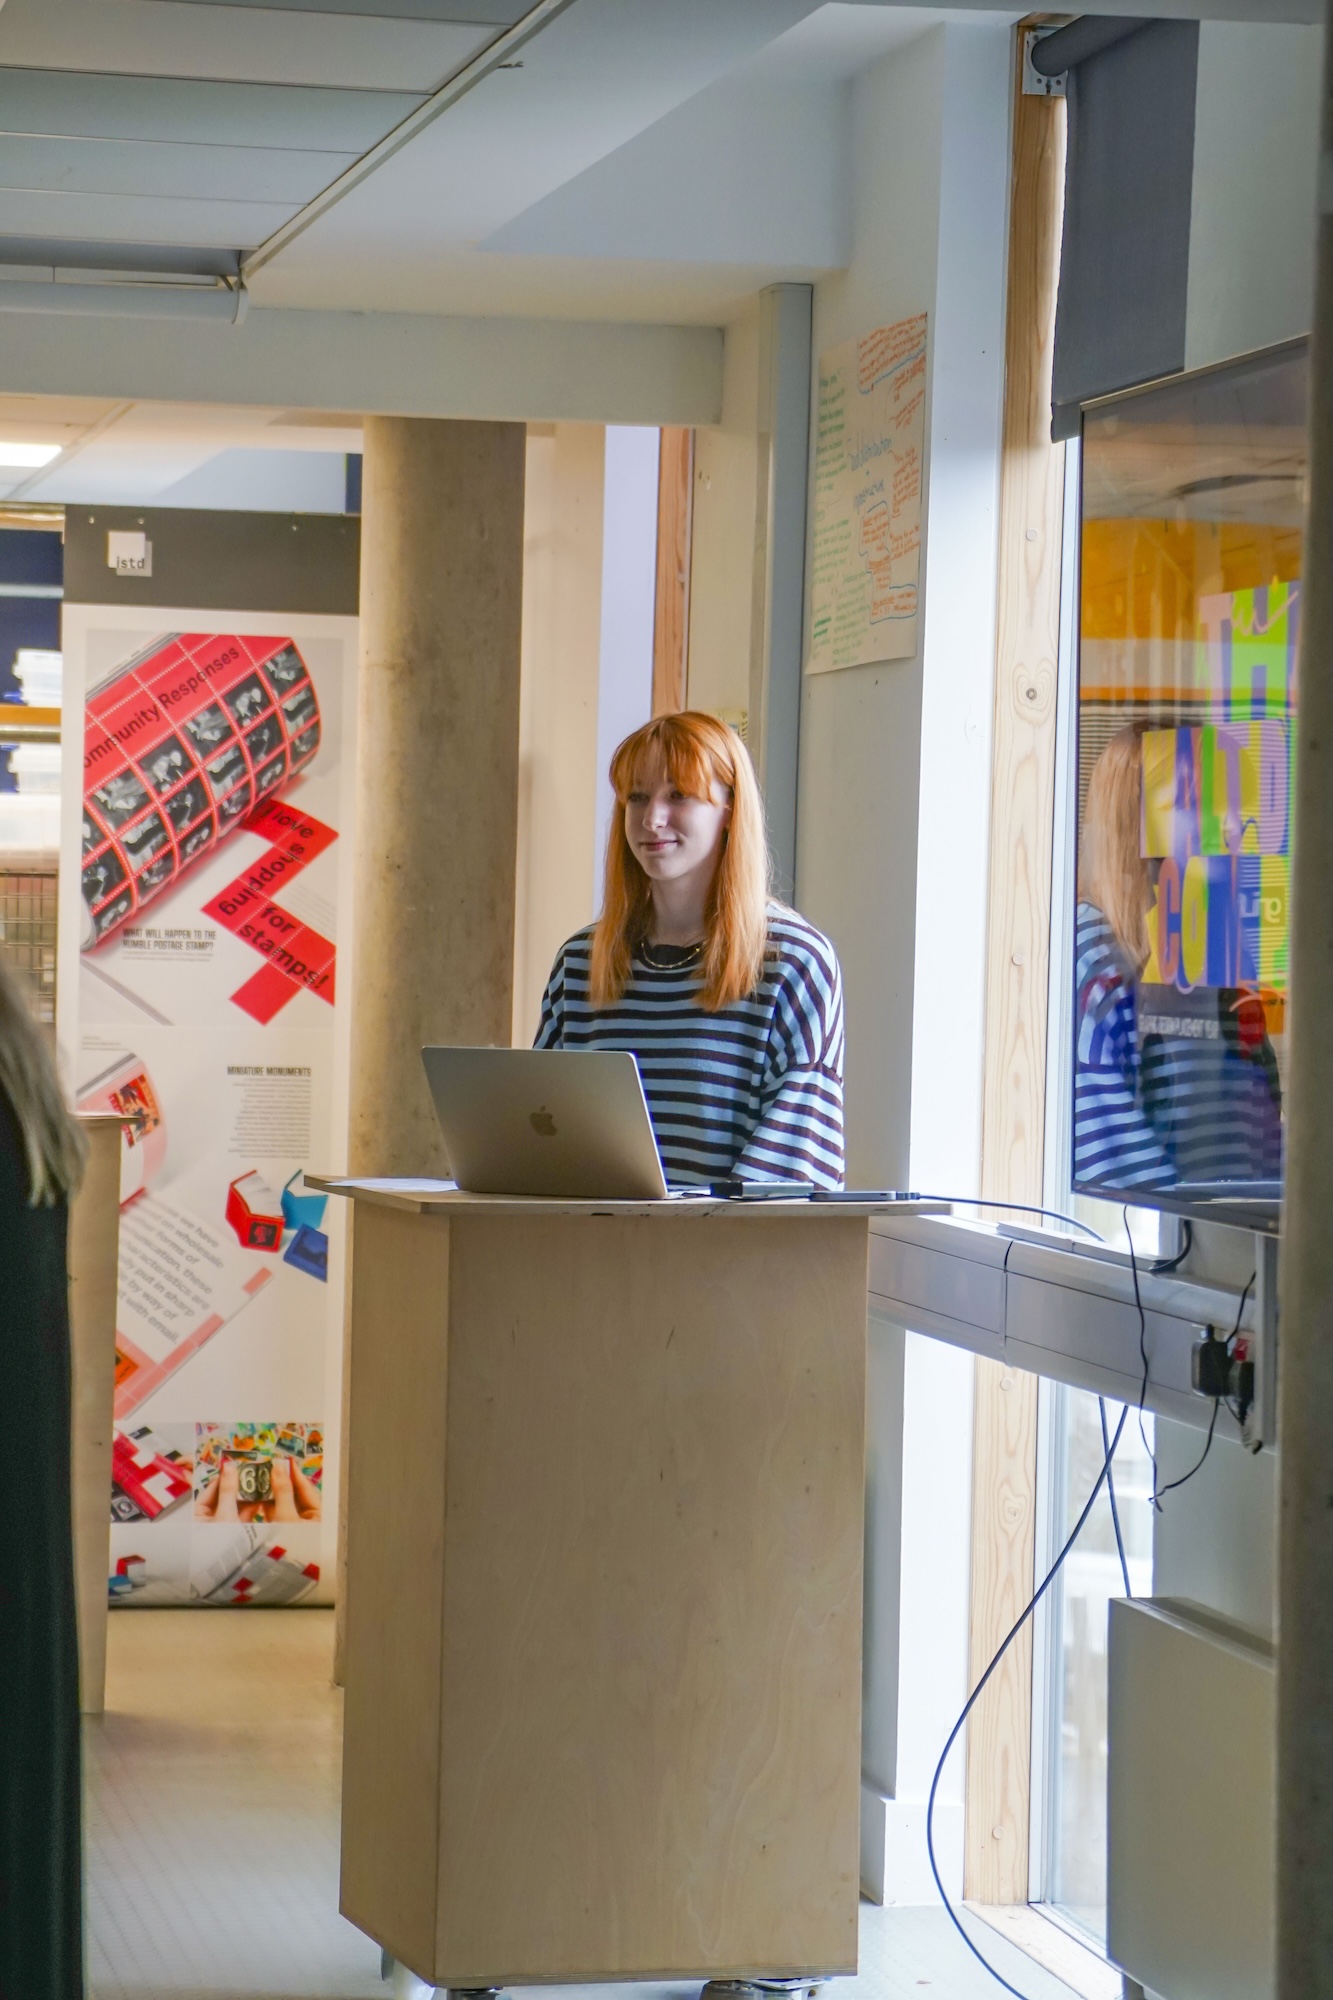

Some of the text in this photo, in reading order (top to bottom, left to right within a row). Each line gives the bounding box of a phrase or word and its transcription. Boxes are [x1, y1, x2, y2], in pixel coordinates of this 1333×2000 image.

[158, 646, 240, 710] Responses
[272, 808, 314, 840] love
[218, 842, 305, 916] shopping
[260, 906, 297, 934] for
[123, 928, 216, 941] WHAT WILL HAPPEN TO THE
[123, 939, 214, 952] HUMBLE POSTAGE STAMP?
[239, 924, 330, 990] stamps!
[227, 1066, 312, 1078] MINIATURE MONUMENTS
[157, 1231, 185, 1257] forms
[195, 1227, 219, 1248] have
[133, 1267, 155, 1285] put
[164, 1290, 196, 1318] sharp
[182, 1268, 213, 1295] these
[142, 1291, 163, 1312] way
[191, 1293, 211, 1311] are
